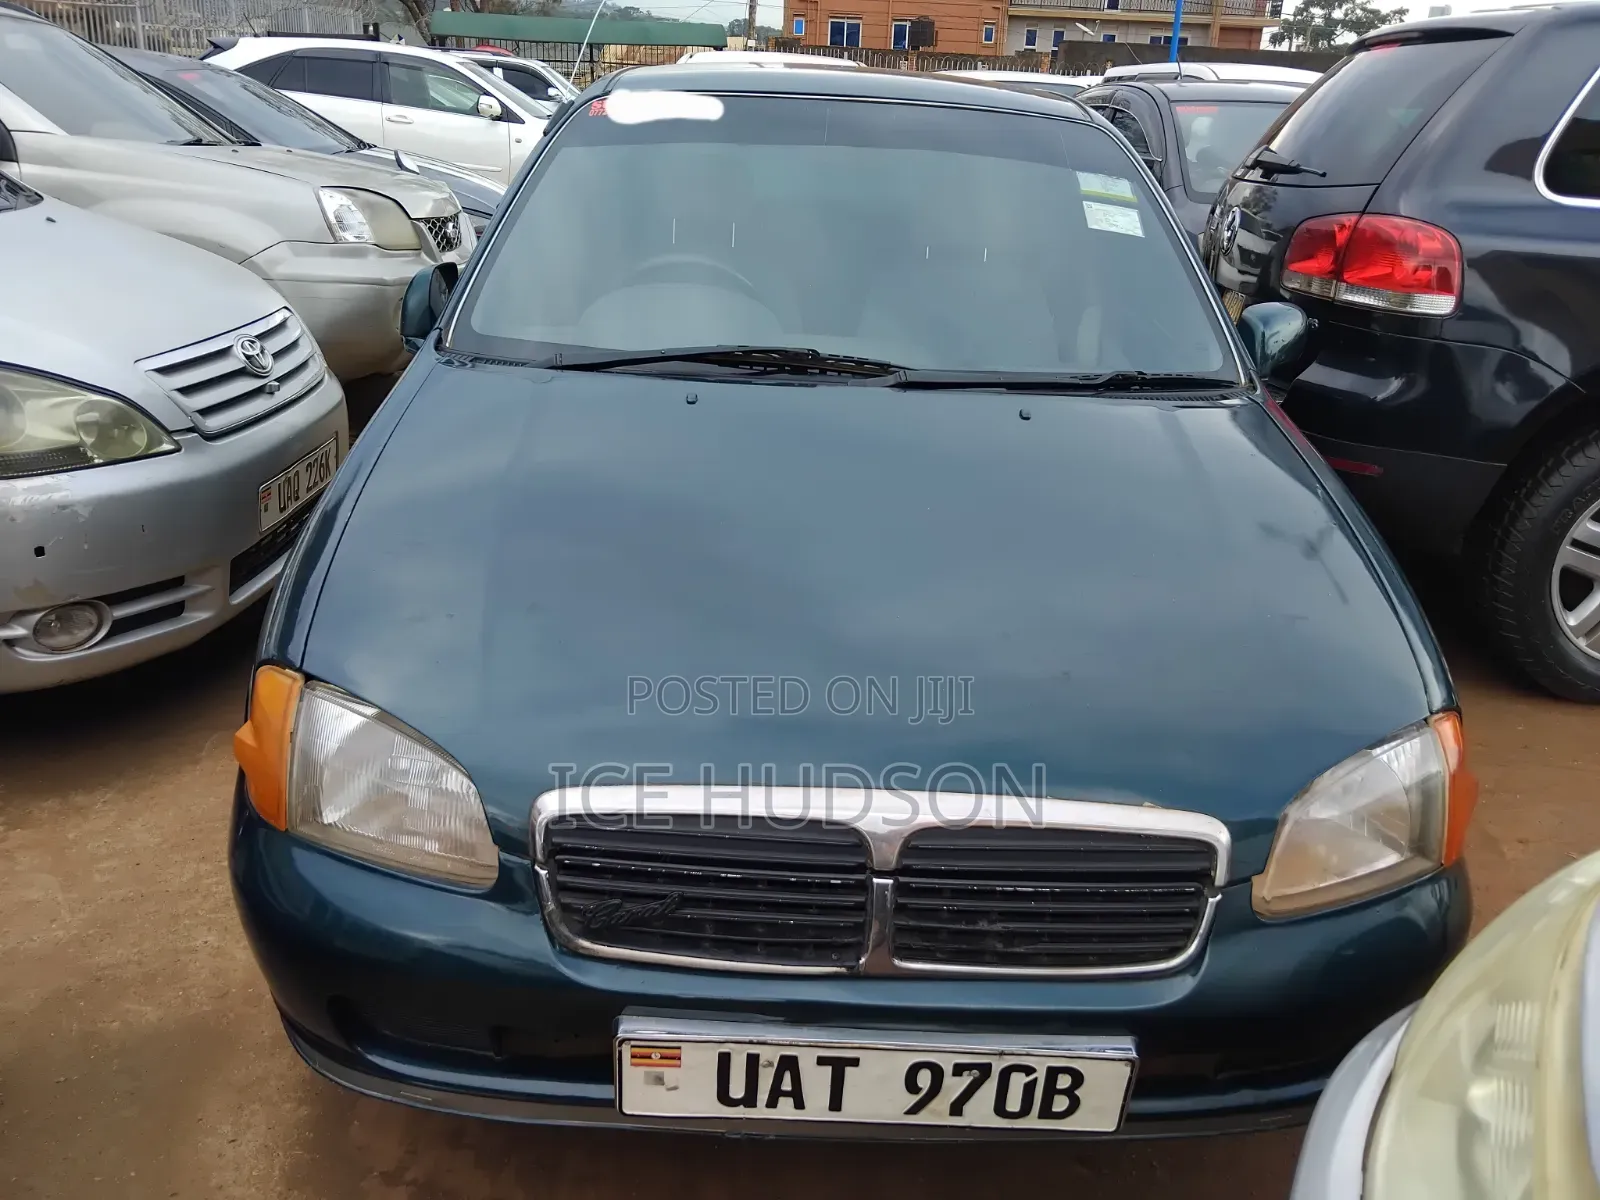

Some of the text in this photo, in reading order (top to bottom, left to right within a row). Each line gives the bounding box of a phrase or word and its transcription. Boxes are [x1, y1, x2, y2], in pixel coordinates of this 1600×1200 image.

[277, 446, 331, 513] UAQ 226K
[716, 1050, 1085, 1121] UAT 970B
